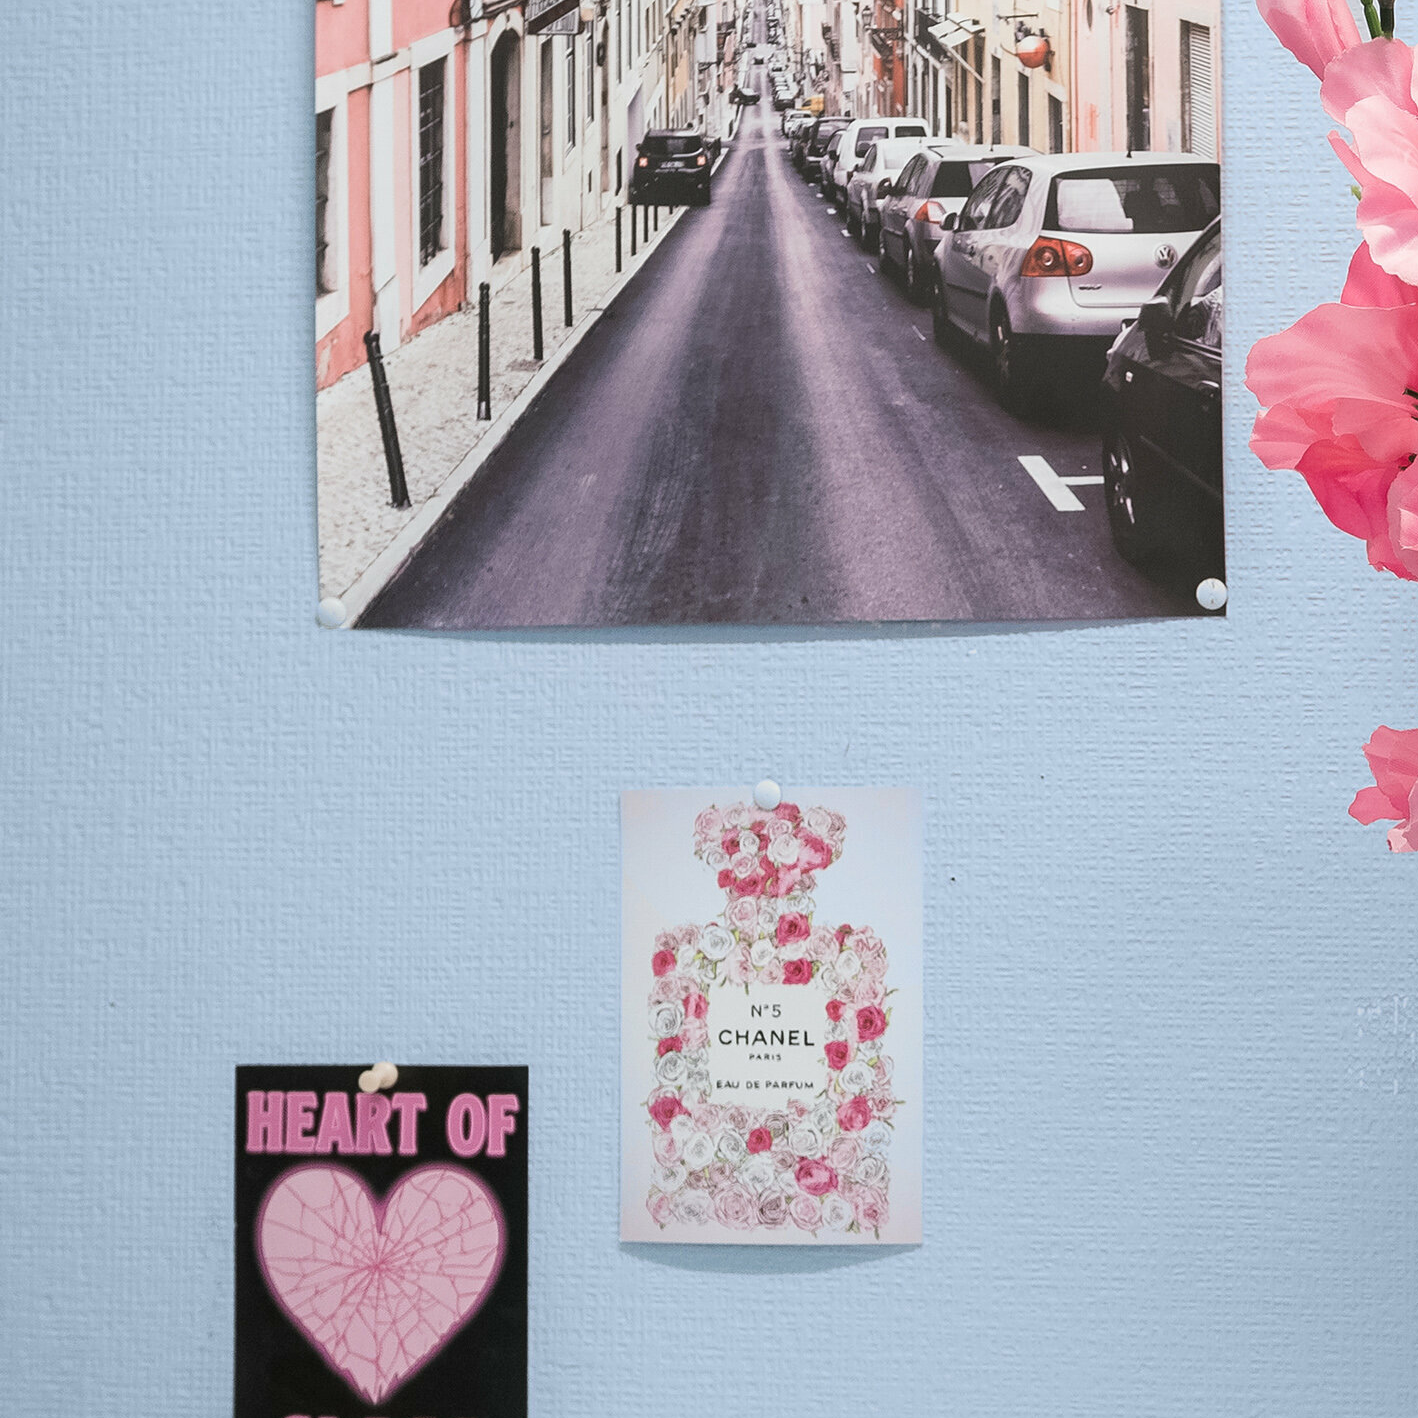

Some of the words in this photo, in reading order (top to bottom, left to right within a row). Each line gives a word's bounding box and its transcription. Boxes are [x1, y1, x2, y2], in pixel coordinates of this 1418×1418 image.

[718, 1028, 816, 1047] CHANEL
[748, 1052, 782, 1062] PARIS
[716, 1079, 740, 1090] EAU
[745, 1080, 760, 1090] DE
[765, 1080, 814, 1090] PARFUM
[246, 1090, 428, 1156] HEART
[446, 1092, 520, 1158] OF
